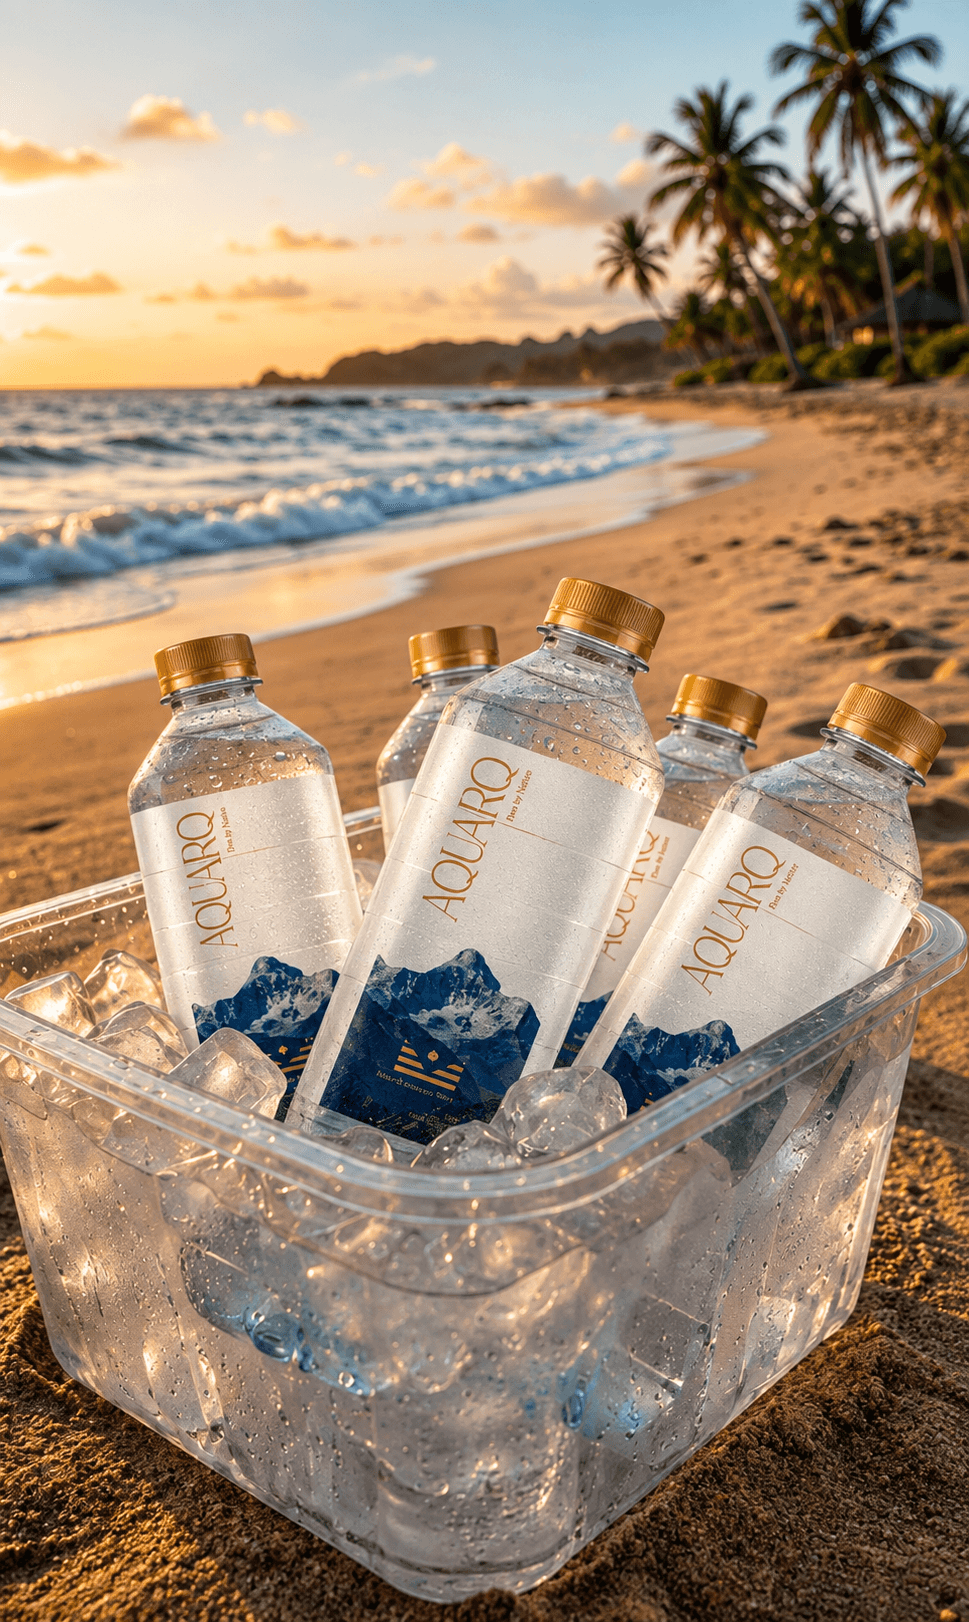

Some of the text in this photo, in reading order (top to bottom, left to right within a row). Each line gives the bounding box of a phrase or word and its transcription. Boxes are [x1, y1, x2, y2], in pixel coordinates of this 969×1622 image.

[176, 810, 238, 948] AQUARQ
[422, 756, 520, 923] AQUARQ
[681, 845, 787, 996] AQUARQ
